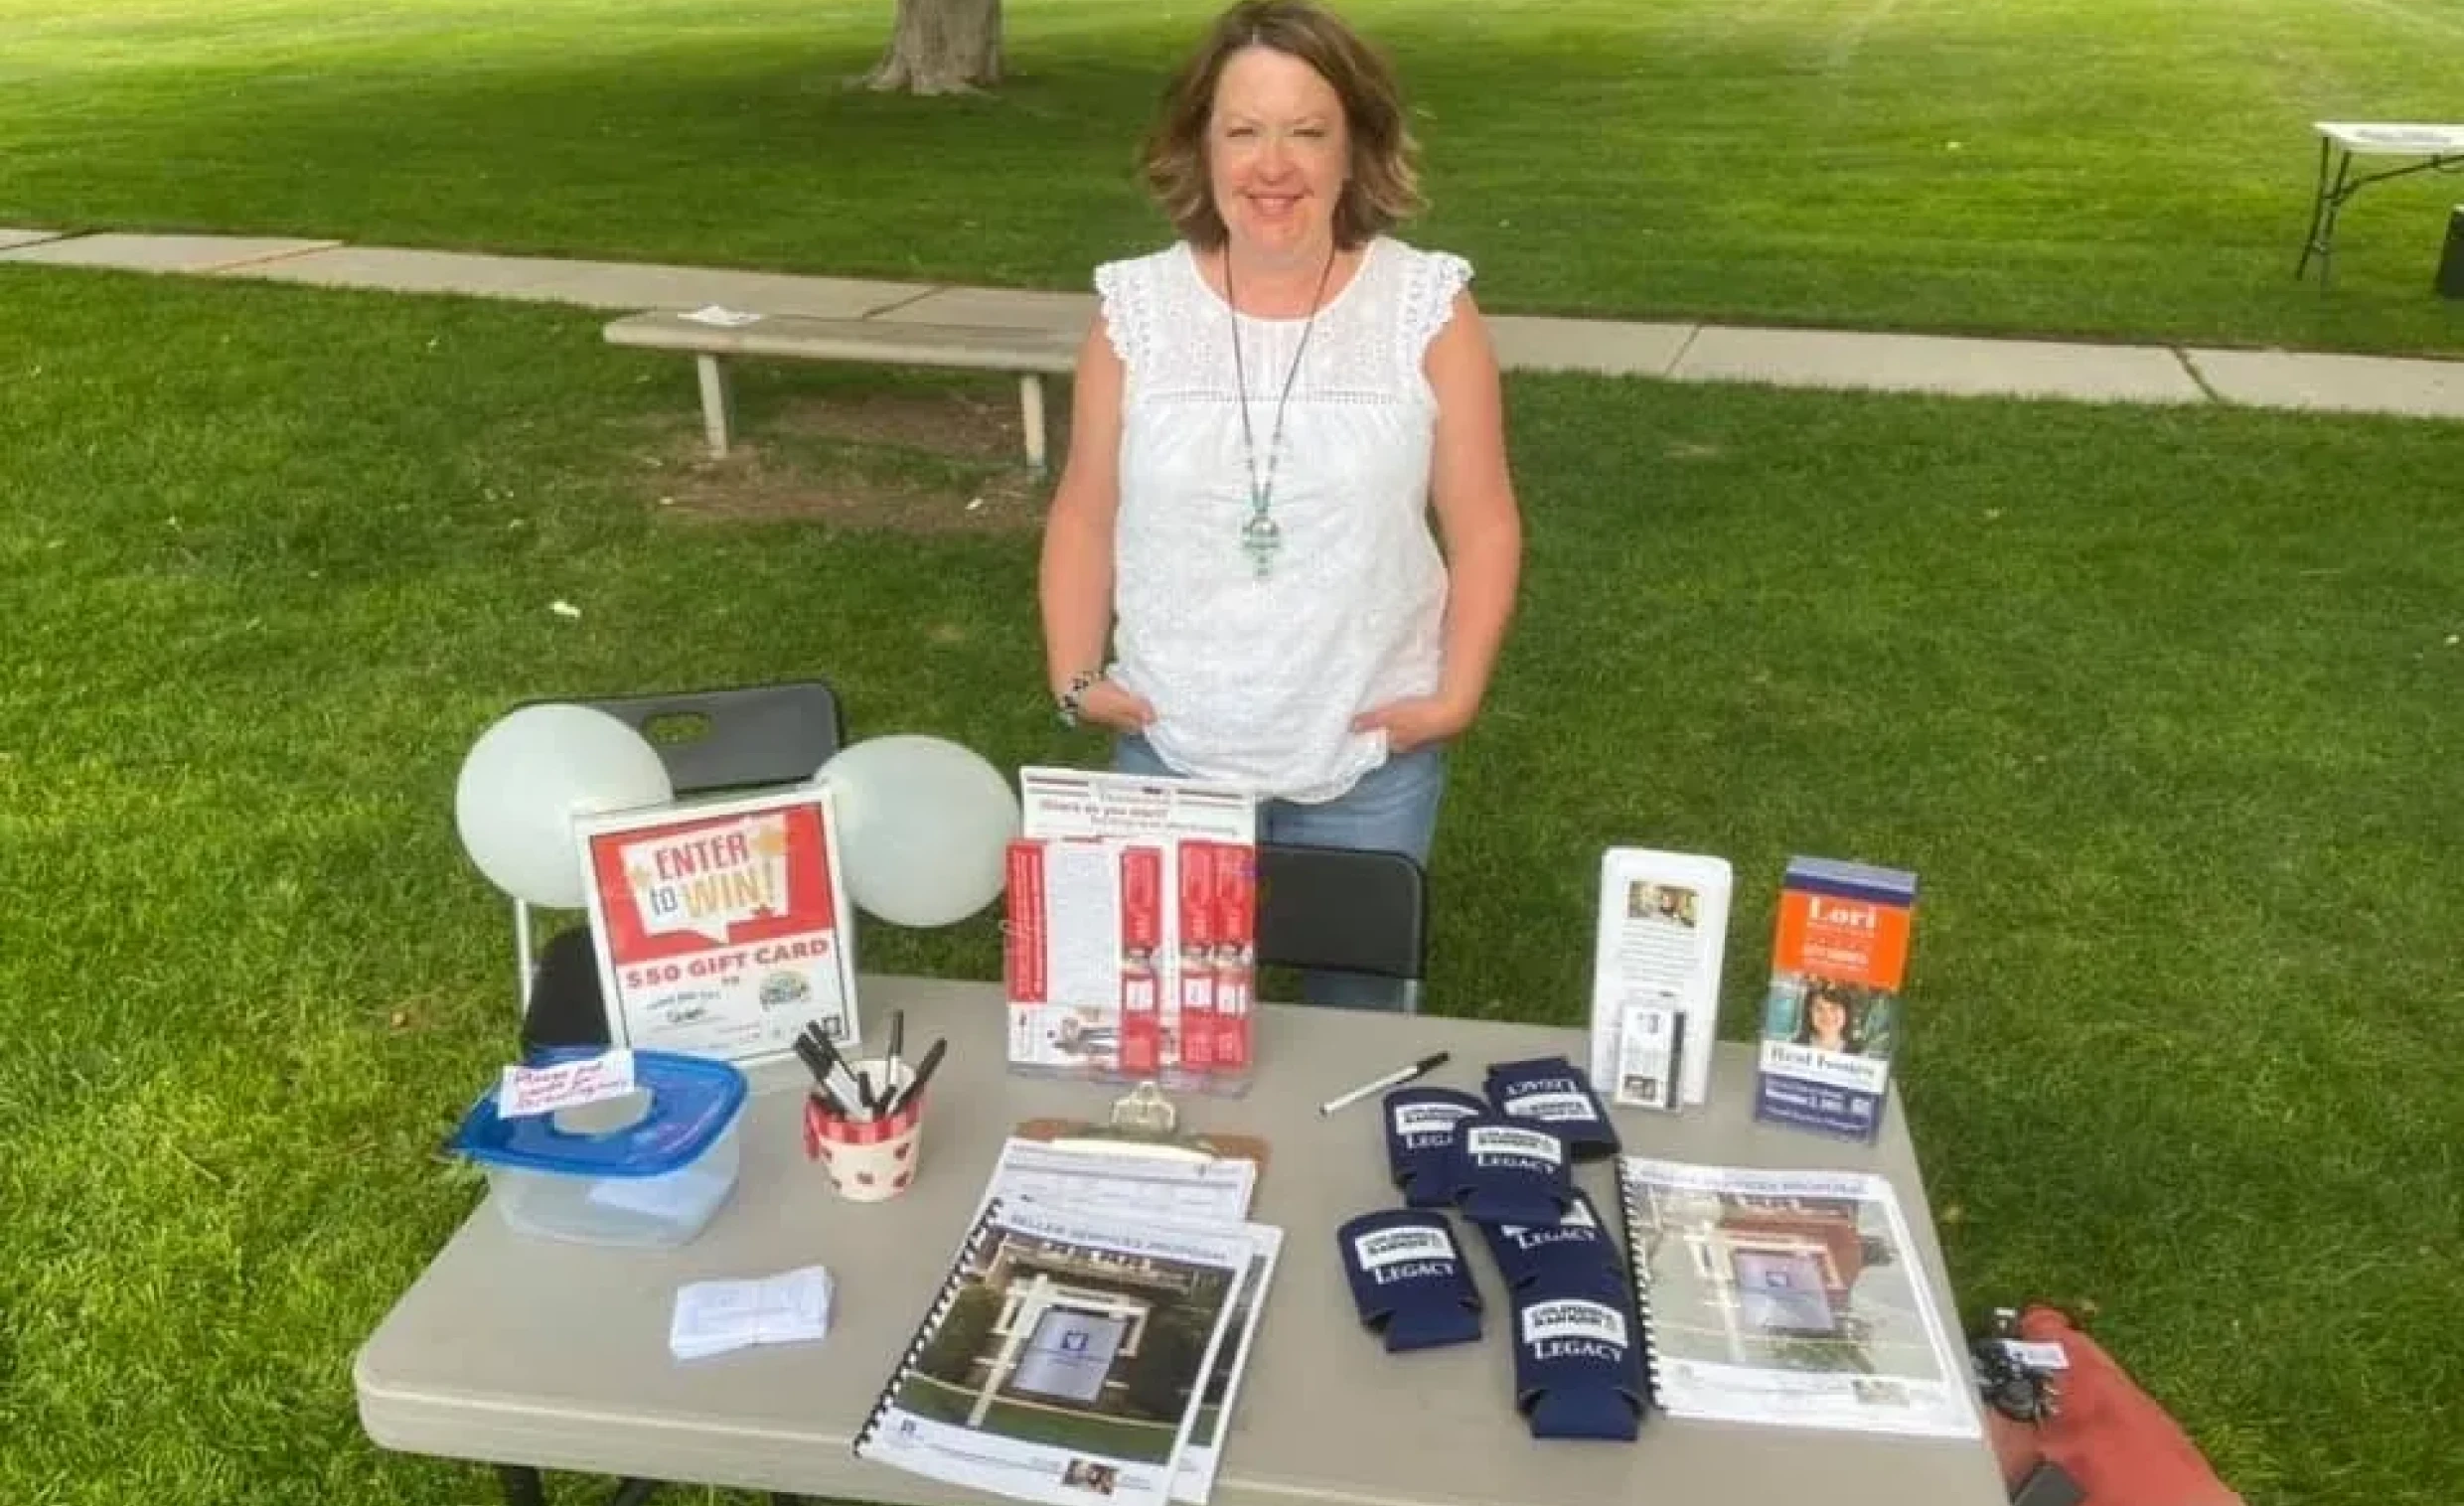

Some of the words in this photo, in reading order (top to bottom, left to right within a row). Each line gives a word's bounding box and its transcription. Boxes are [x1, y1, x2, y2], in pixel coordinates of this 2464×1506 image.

[654, 832, 747, 878] ENTER
[685, 861, 774, 916] WIN!
[1808, 896, 1875, 928] Lori
[626, 964, 682, 989] $50
[687, 952, 746, 977] GIFT
[754, 939, 829, 965] CARD
[1477, 1153, 1555, 1174] LEGACY
[1519, 1228, 1596, 1250] LEGACY
[1375, 1263, 1455, 1284] LEGACY
[1534, 1340, 1623, 1362] LEGACY
